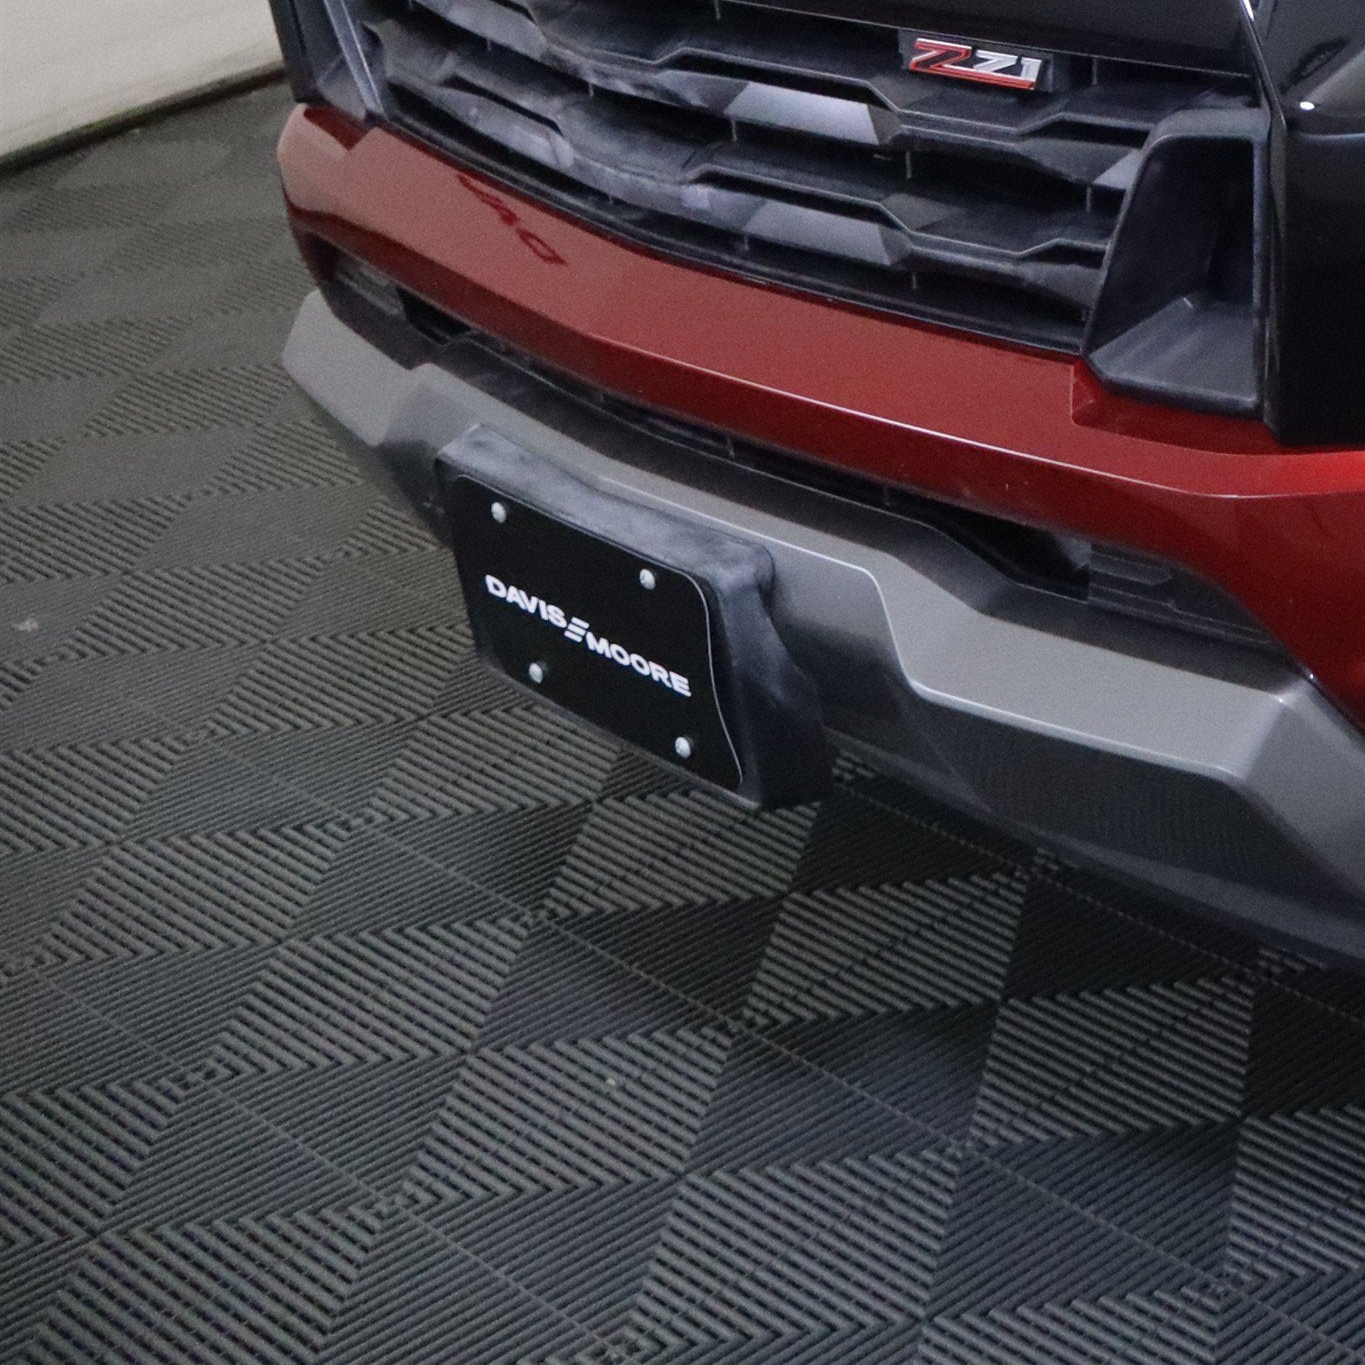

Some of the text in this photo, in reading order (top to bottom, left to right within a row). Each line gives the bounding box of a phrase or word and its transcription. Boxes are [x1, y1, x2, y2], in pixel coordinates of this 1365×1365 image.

[909, 37, 1043, 91] Z71
[484, 573, 692, 698] DAVIS MOORE
